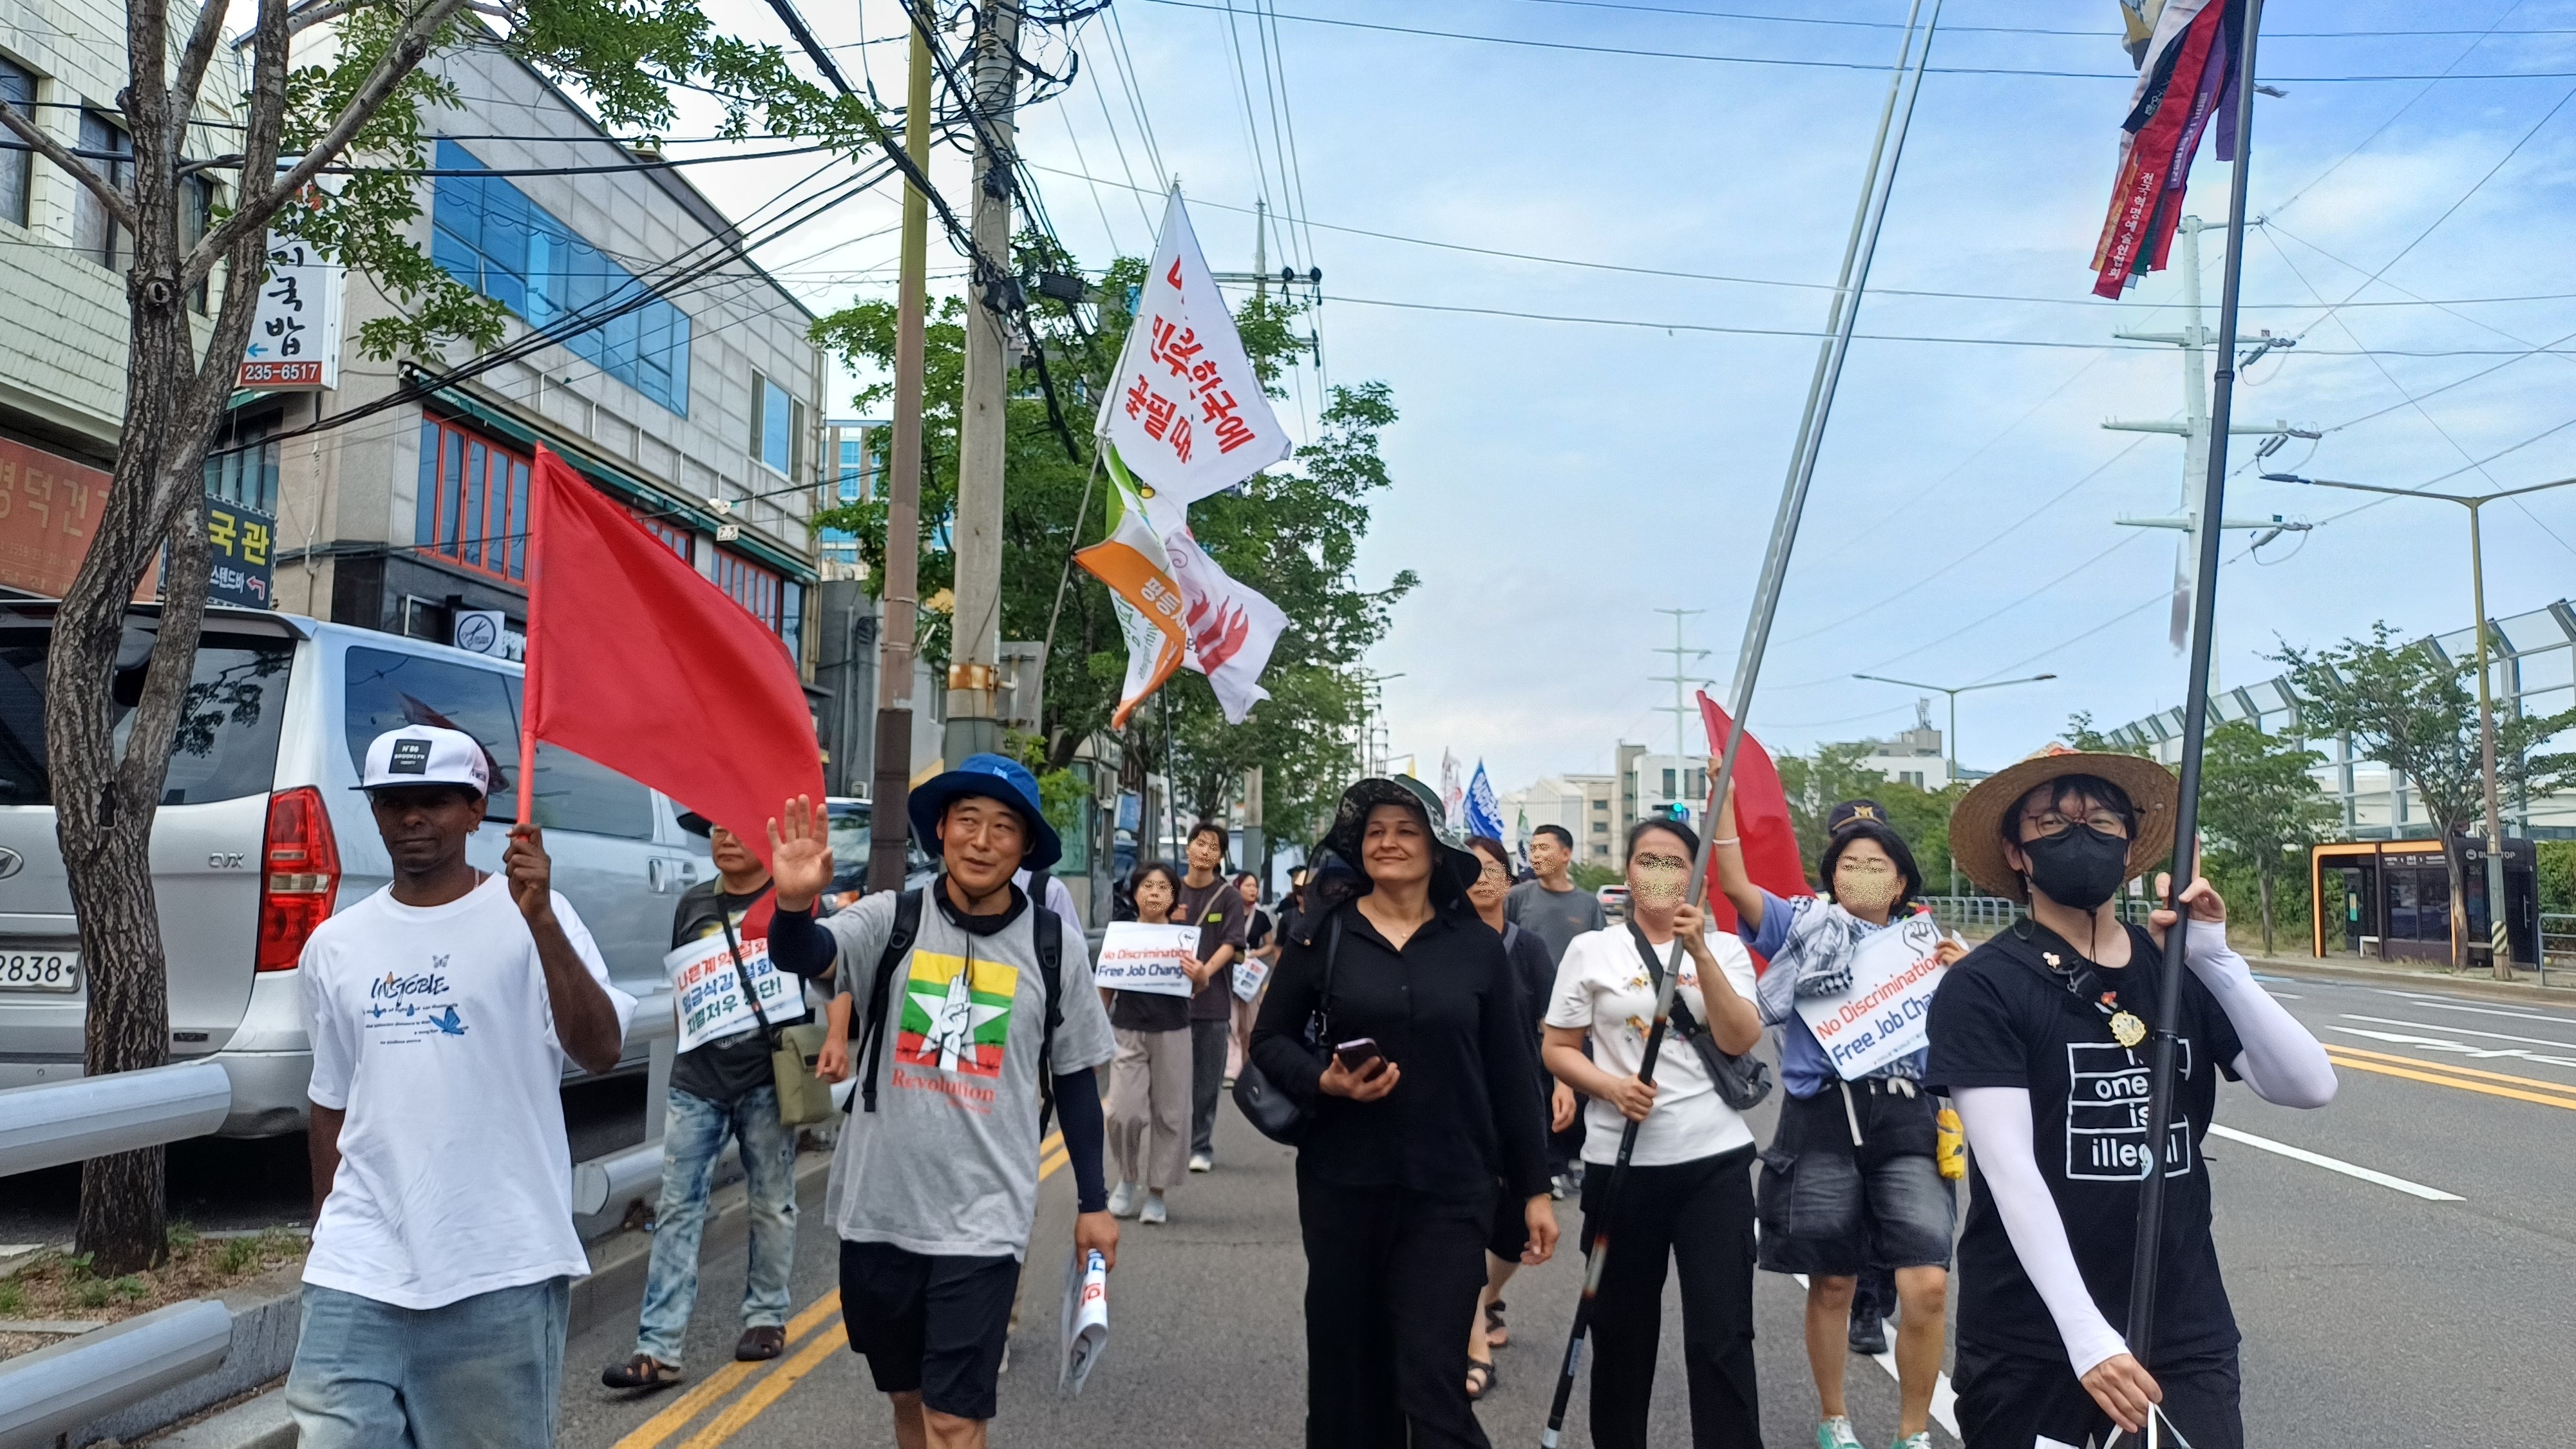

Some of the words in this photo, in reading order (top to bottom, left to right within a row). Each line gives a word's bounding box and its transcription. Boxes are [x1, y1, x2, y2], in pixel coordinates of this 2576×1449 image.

[245, 365, 318, 380] 235-6517
[1099, 965, 1124, 977] Free
[1126, 964, 1146, 977] Job
[1148, 963, 1184, 980] Chang
[1816, 1018, 1842, 1041] No
[1832, 1032, 1876, 1066] Free
[1875, 1010, 1904, 1040] Job
[891, 1068, 996, 1102] Revolution
[2095, 1075, 2148, 1099] one
[2128, 1102, 2149, 1128] is
